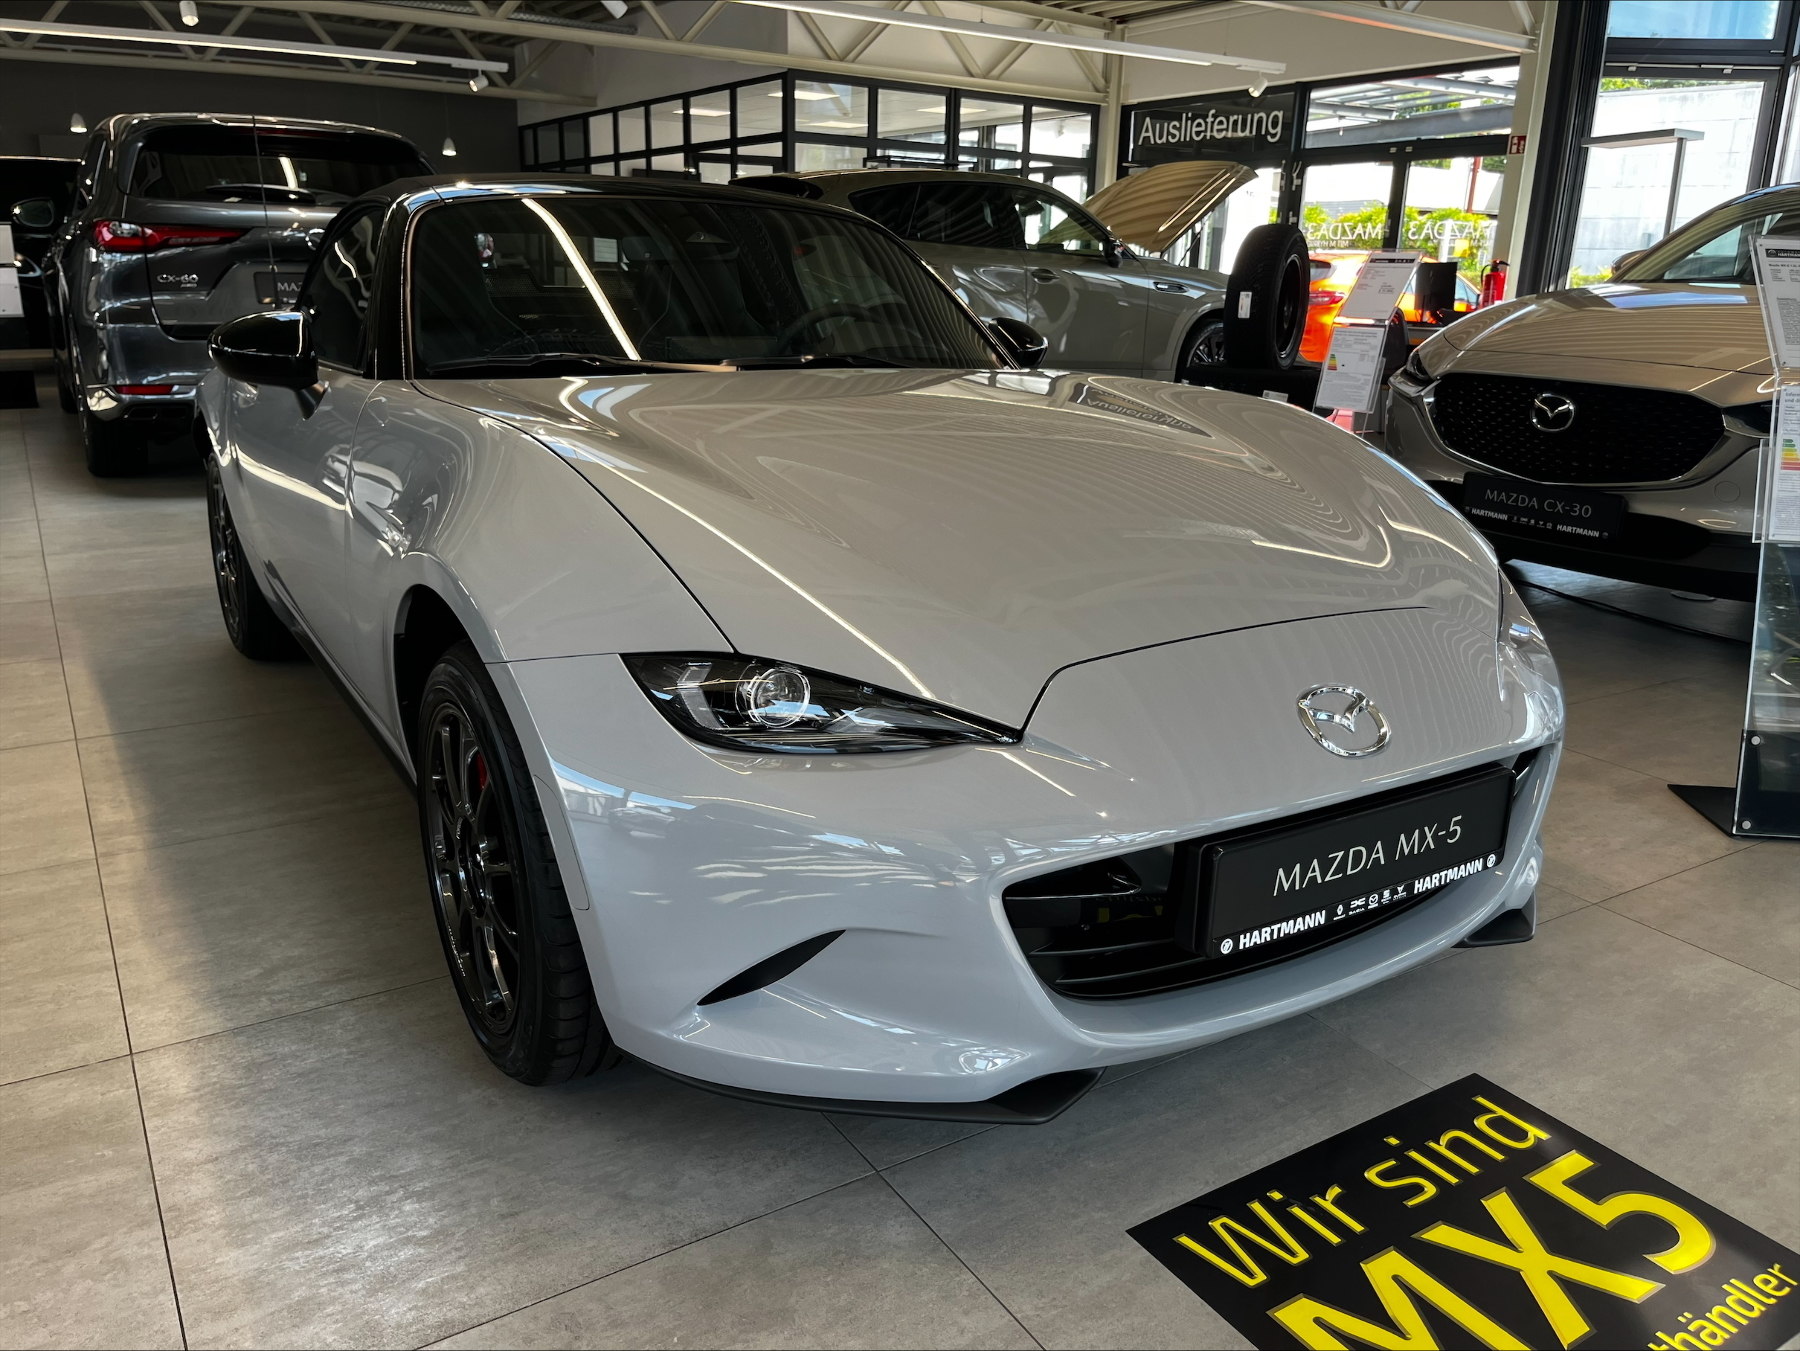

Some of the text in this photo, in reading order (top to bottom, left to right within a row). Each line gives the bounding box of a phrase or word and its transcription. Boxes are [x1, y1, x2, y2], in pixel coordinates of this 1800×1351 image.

[1138, 109, 1284, 146] Auslieferung
[157, 273, 199, 284] CX-60
[1471, 507, 1600, 538] HARTMANN HARTMANN
[1485, 488, 1592, 518] MAZDA CX-30
[1273, 815, 1462, 897] MAZDA MX-5
[1239, 910, 1326, 950] HARTMANN
[1414, 858, 1484, 894] HARTMANN
[1173, 1095, 1551, 1288] Wir sind
[1268, 1150, 1716, 1350] MX5
